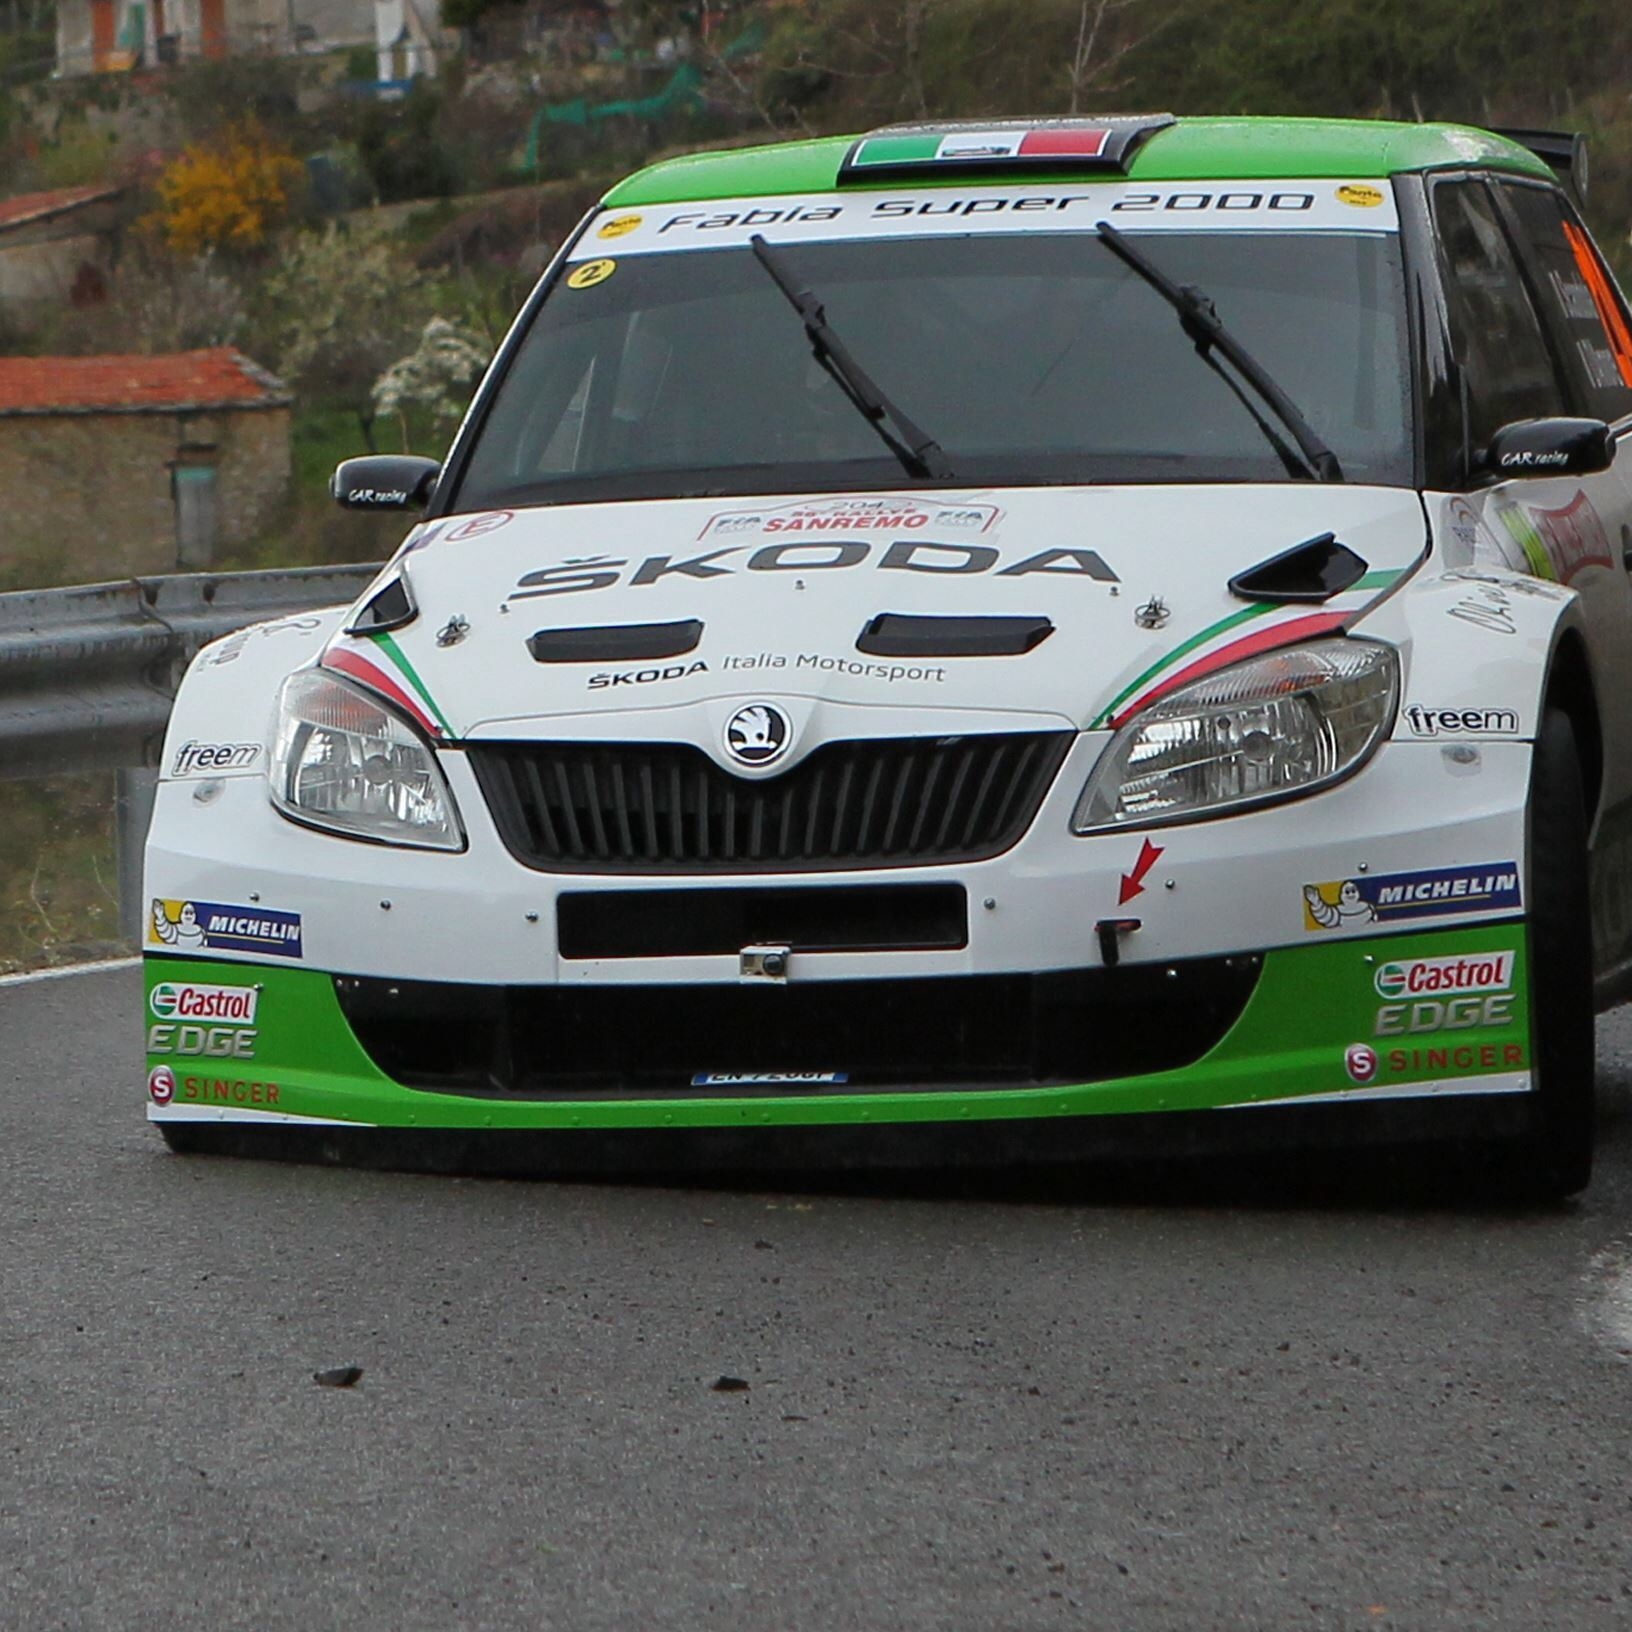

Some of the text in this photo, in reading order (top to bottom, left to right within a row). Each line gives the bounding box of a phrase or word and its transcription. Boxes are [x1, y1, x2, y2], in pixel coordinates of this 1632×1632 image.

[657, 192, 1316, 235] Fabia Super 2000
[1501, 450, 1570, 466] CAR racing
[349, 489, 375, 503] CAR
[762, 513, 930, 533] SANREMO
[507, 540, 1123, 602] ŠKODA
[587, 653, 947, 690] ŠKODA Italia Motorsport
[1408, 706, 1516, 734] freem
[176, 742, 260, 774] freem
[1378, 873, 1517, 905] MICHELIN
[208, 914, 301, 941] MICHELIN
[1408, 957, 1504, 992] Castrol
[177, 988, 252, 1020] Castrol
[1374, 994, 1516, 1037] EDGE
[147, 1025, 259, 1058] EDGE
[1389, 1045, 1523, 1071] SINGER
[184, 1077, 280, 1104] SINGER
